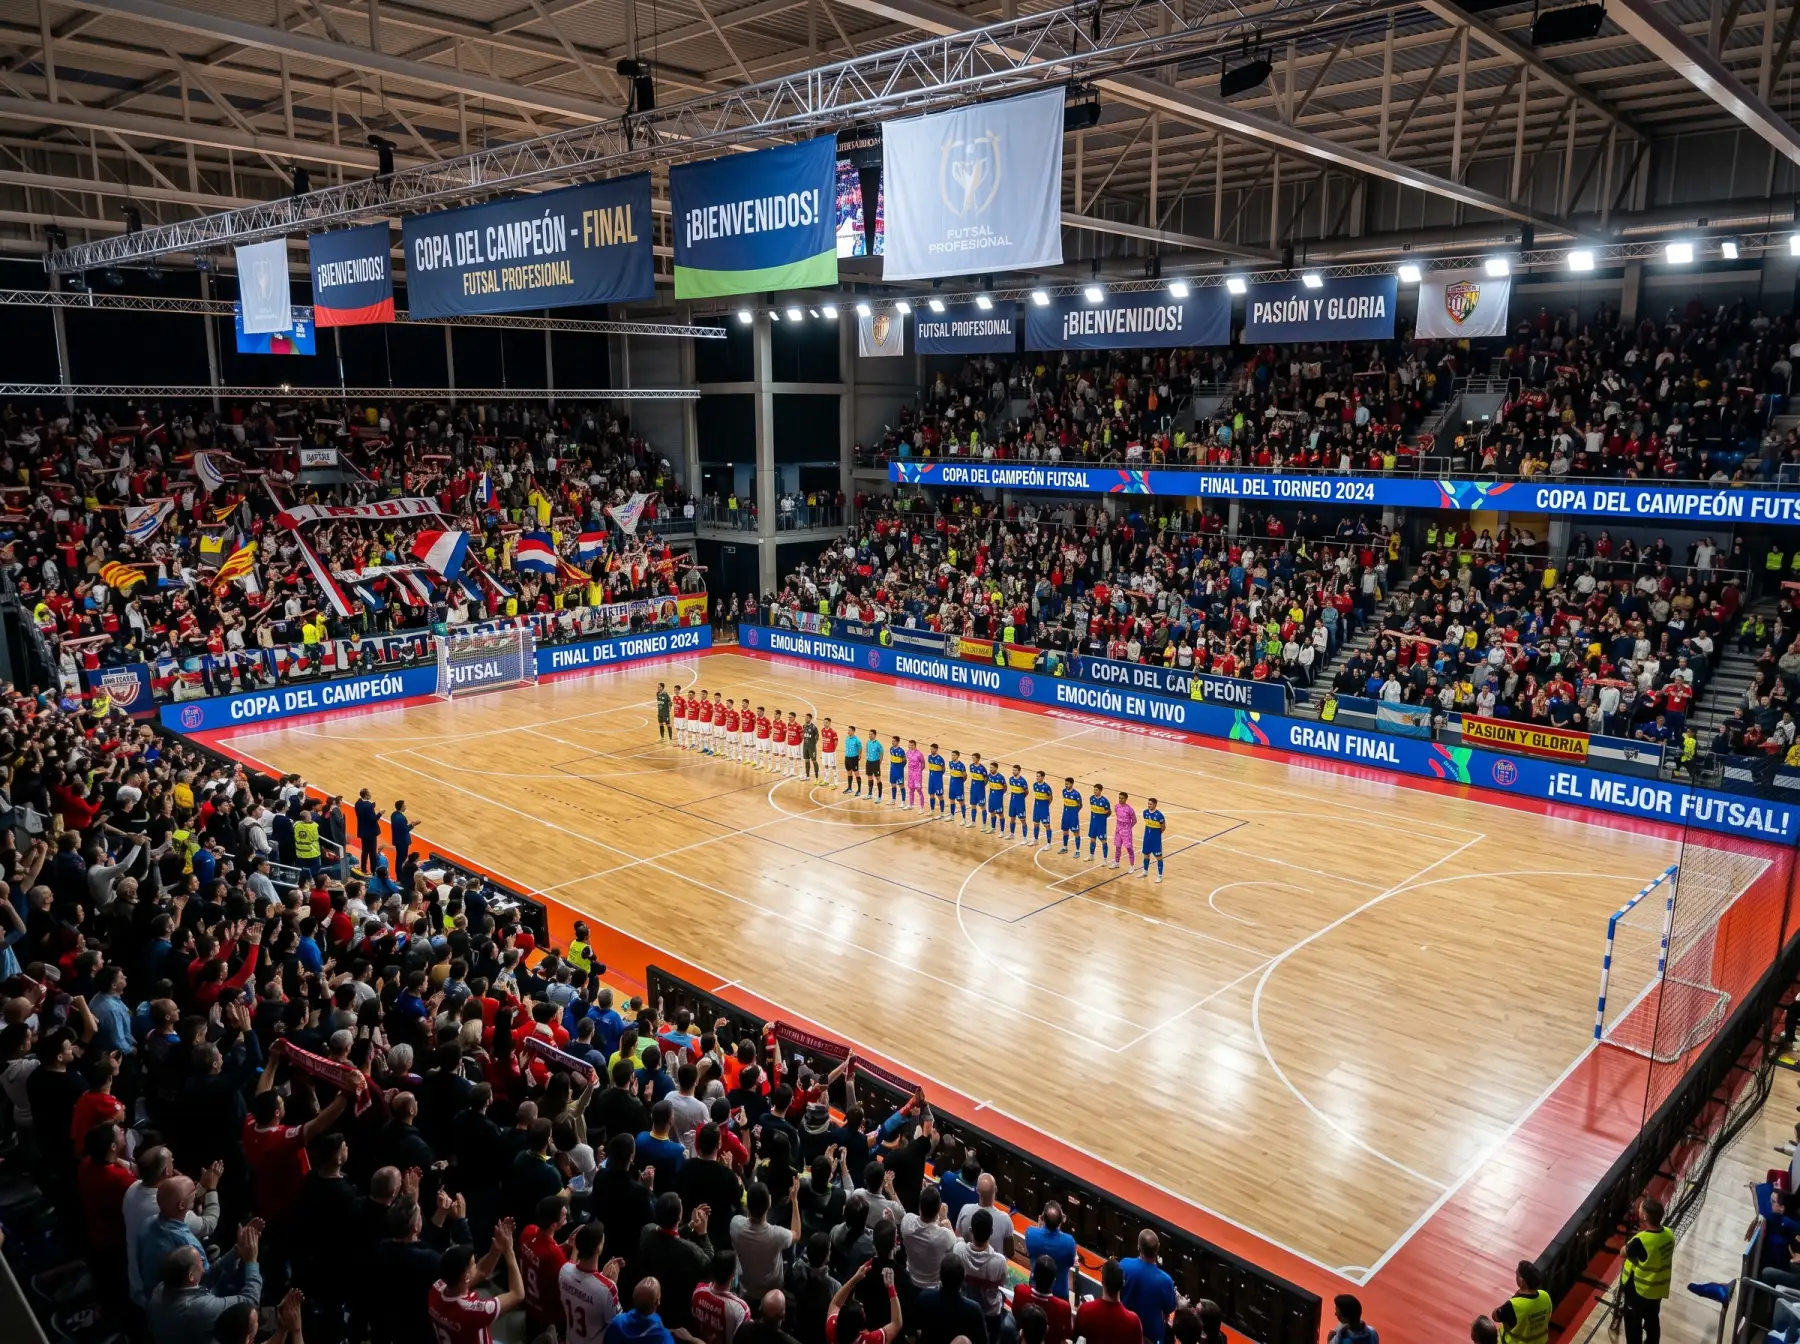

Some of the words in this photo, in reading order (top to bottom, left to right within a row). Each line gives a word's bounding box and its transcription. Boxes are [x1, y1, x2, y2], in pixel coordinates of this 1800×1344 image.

[687, 189, 818, 247] ¡BIENVENIDOS!
[947, 226, 993, 240] FUTSAL
[416, 235, 453, 271] COPA
[456, 230, 484, 265] DEL
[487, 209, 566, 261] CAMPEÓN
[571, 228, 578, 236] -
[583, 204, 637, 248] FINAL
[929, 236, 1013, 254] PROFESIONAL
[318, 256, 384, 292] ¡BIENVENIDOS!
[463, 270, 500, 295] FUTSAL
[502, 260, 573, 291] PROFESIONAL
[1064, 305, 1183, 340] ¡BIENVENIDOS!
[1254, 296, 1308, 323] PASIÓN
[1314, 299, 1324, 320] Y
[1328, 296, 1385, 319] GLORIA
[919, 323, 949, 338] FUTSAL
[952, 319, 1011, 336] PROFESIONAL
[943, 468, 968, 482] COPA
[971, 469, 990, 483] DEL
[992, 468, 1044, 485] CAMPEÓN
[1047, 472, 1089, 487] FUTSAL
[1201, 477, 1239, 494] FINAL
[1243, 479, 1268, 495] DEL
[1273, 480, 1331, 498] TORNEO
[1336, 482, 1374, 500] 2024
[1537, 489, 1586, 509] COPA
[1593, 492, 1630, 511] DEL
[1637, 491, 1743, 516] CAMPEÓN
[553, 648, 589, 667] FINAL
[594, 644, 616, 660] DEL
[620, 636, 666, 656] TORNEO
[671, 632, 699, 648] 2024
[447, 661, 502, 684] FUTSAL
[897, 656, 948, 679] EMOCIÓN
[952, 666, 967, 683] EN
[971, 669, 999, 689] VIVO
[1092, 663, 1129, 683] COPA
[1134, 670, 1161, 689] DEL
[231, 696, 280, 718] COPA
[285, 690, 318, 710] DEL
[323, 674, 403, 704] CAMPEÓN
[1058, 685, 1121, 711] EMOCIÓN
[1127, 697, 1145, 716] EN
[1150, 701, 1184, 723] VIVO
[1291, 726, 1339, 752] GRAN
[1346, 735, 1399, 763] FINAL
[1467, 722, 1516, 741] PASION
[1520, 731, 1528, 743] Y
[1533, 734, 1583, 753] GLORIA
[1549, 773, 1582, 797] ¡EL
[1590, 779, 1672, 813] MEJOR
[1680, 794, 1789, 834] FUTSAL!
